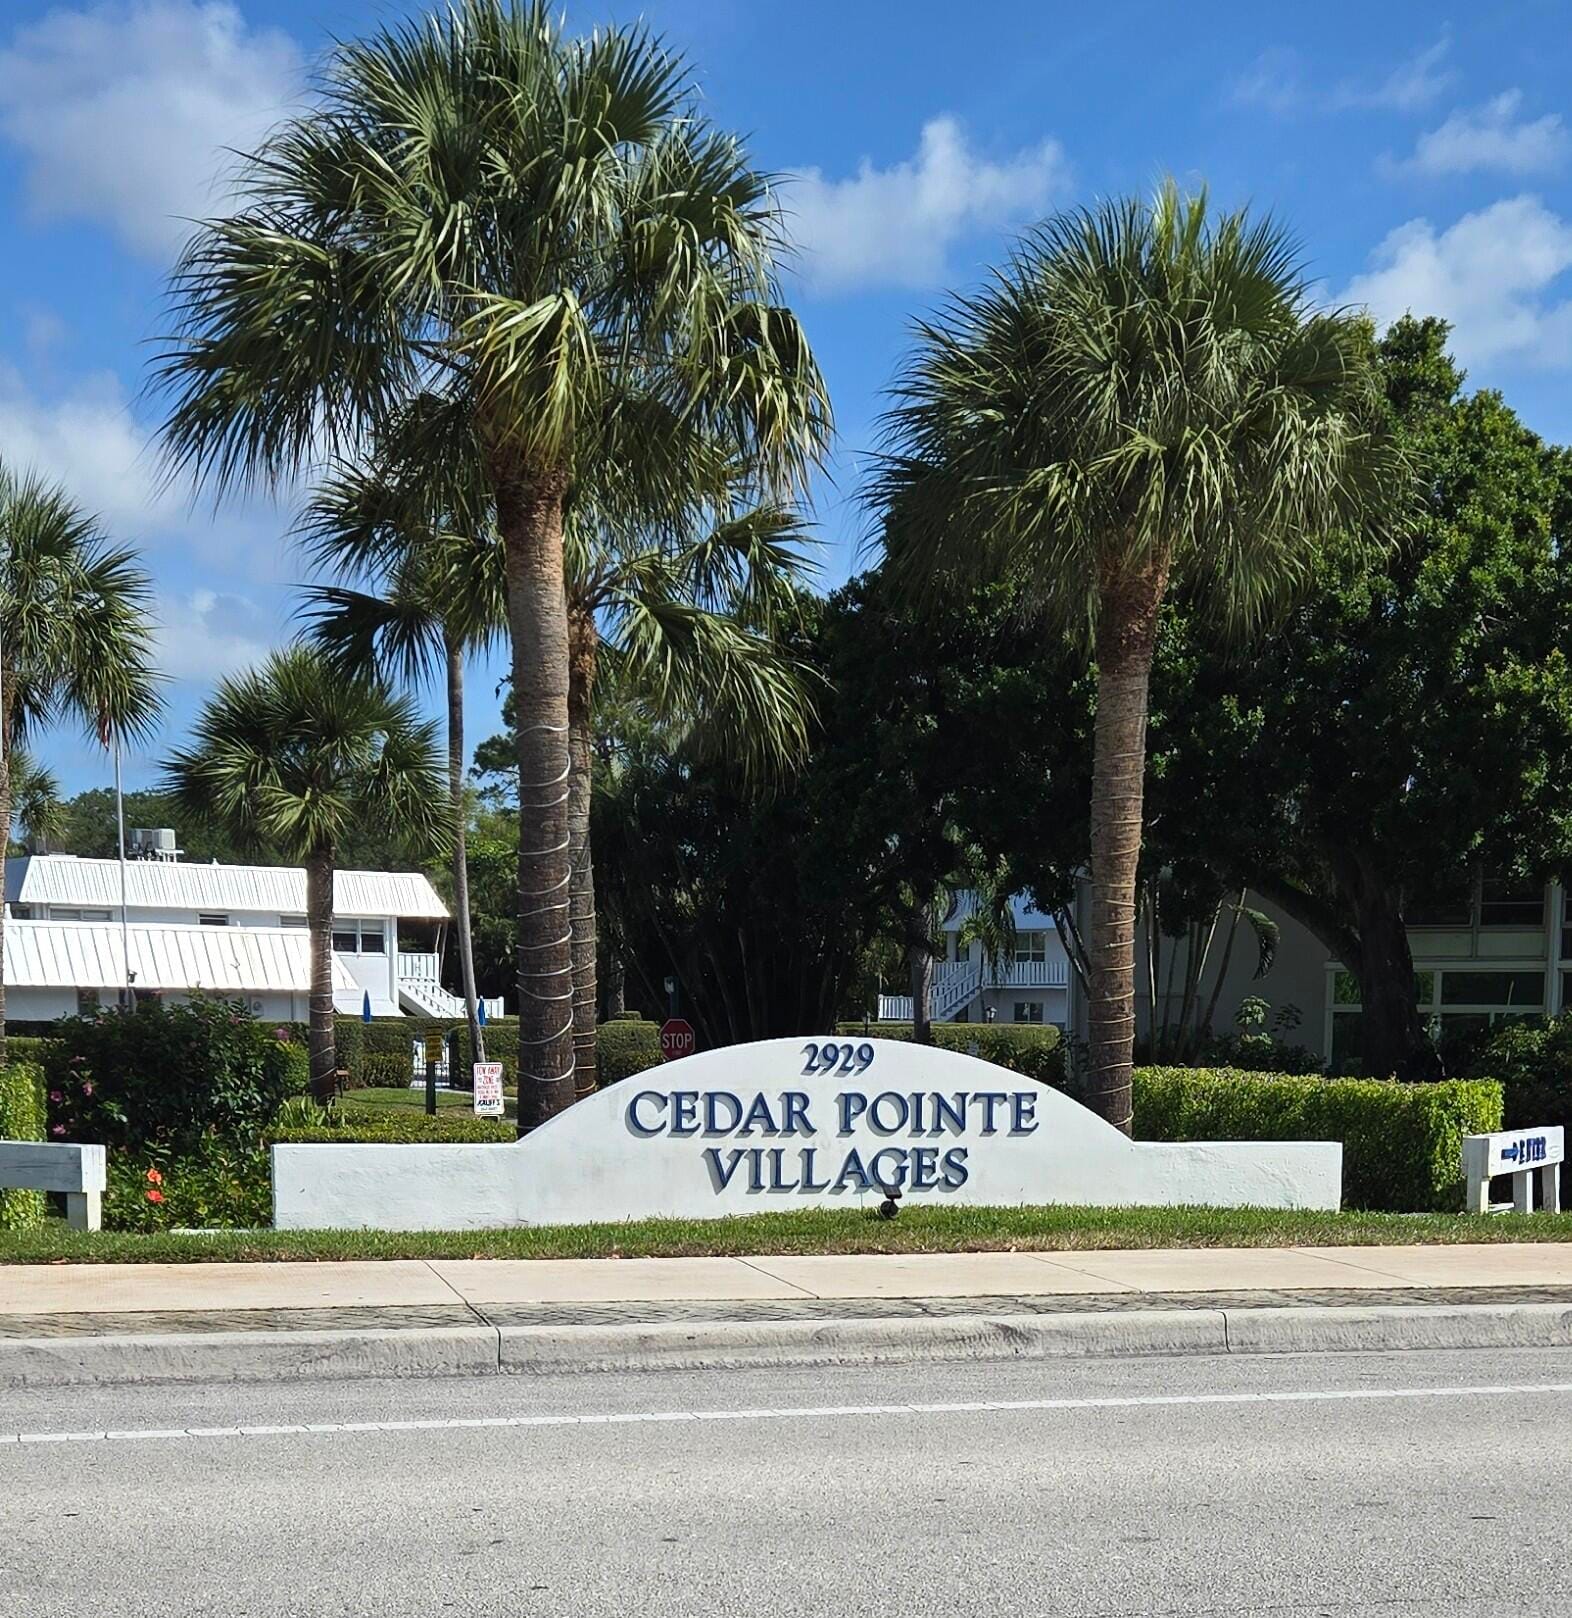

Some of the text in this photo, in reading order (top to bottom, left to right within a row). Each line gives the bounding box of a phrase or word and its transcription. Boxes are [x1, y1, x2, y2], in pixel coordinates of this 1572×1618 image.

[662, 1033, 692, 1049] STOP
[801, 1043, 874, 1076] 2929
[626, 1090, 1039, 1137] CEDAR POINTE
[702, 1147, 969, 1194] VILLAGES
